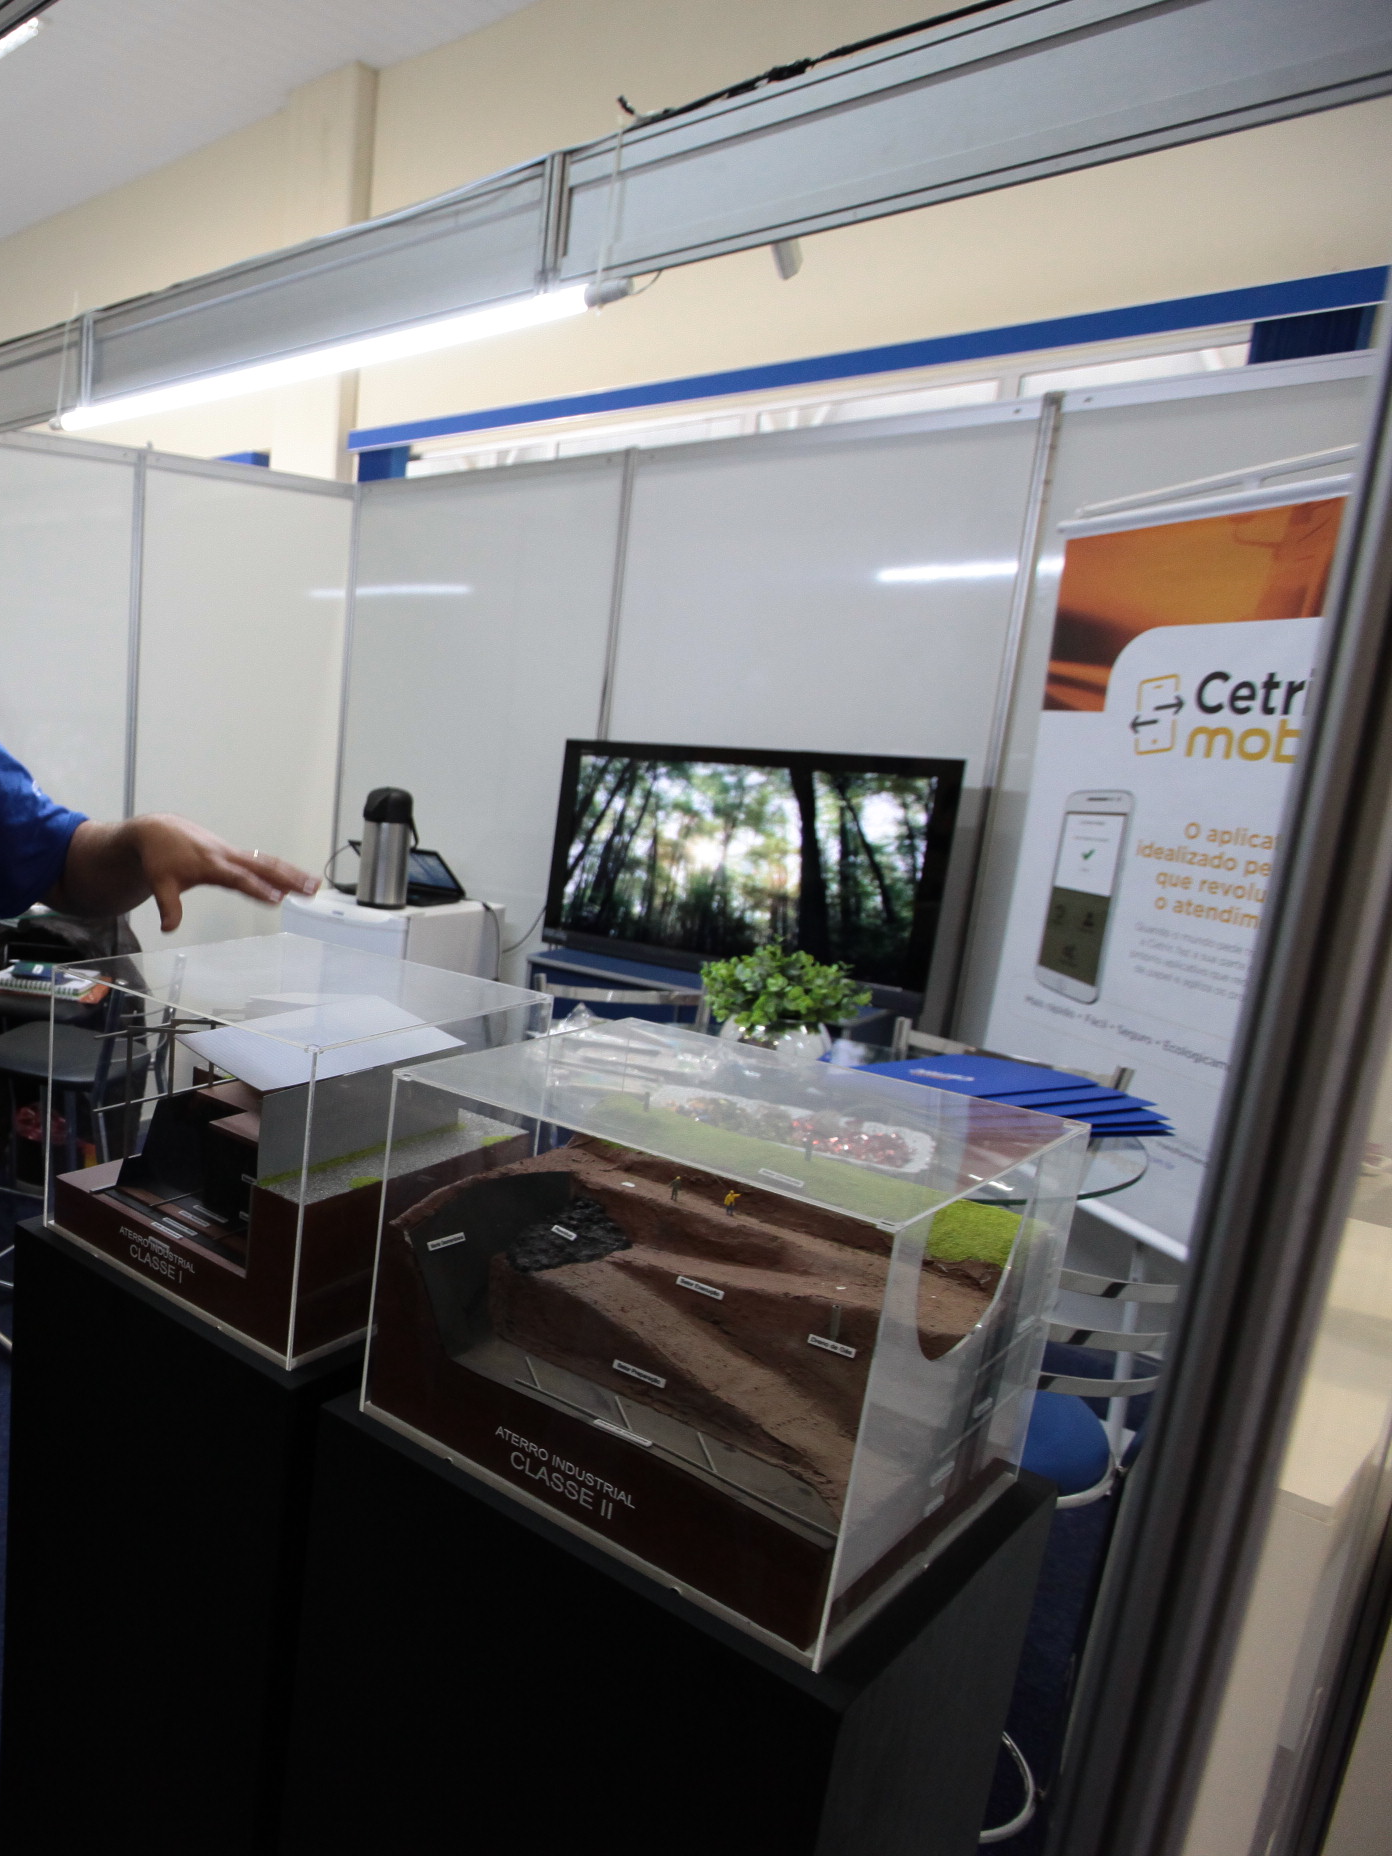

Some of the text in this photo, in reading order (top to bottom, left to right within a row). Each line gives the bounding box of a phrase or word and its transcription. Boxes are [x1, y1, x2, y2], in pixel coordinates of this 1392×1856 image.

[1184, 822, 1201, 840] O
[1136, 839, 1238, 871] idealizado
[1156, 871, 1192, 890] que
[1154, 897, 1168, 910] o
[119, 1225, 149, 1248] ATERRO
[150, 1241, 196, 1274] INDUSTRIAL
[129, 1244, 183, 1284] CLASSE I
[494, 1425, 549, 1461] ATERRO
[551, 1454, 636, 1509] INDUSTRIAL
[510, 1451, 613, 1520] CLASSE II
